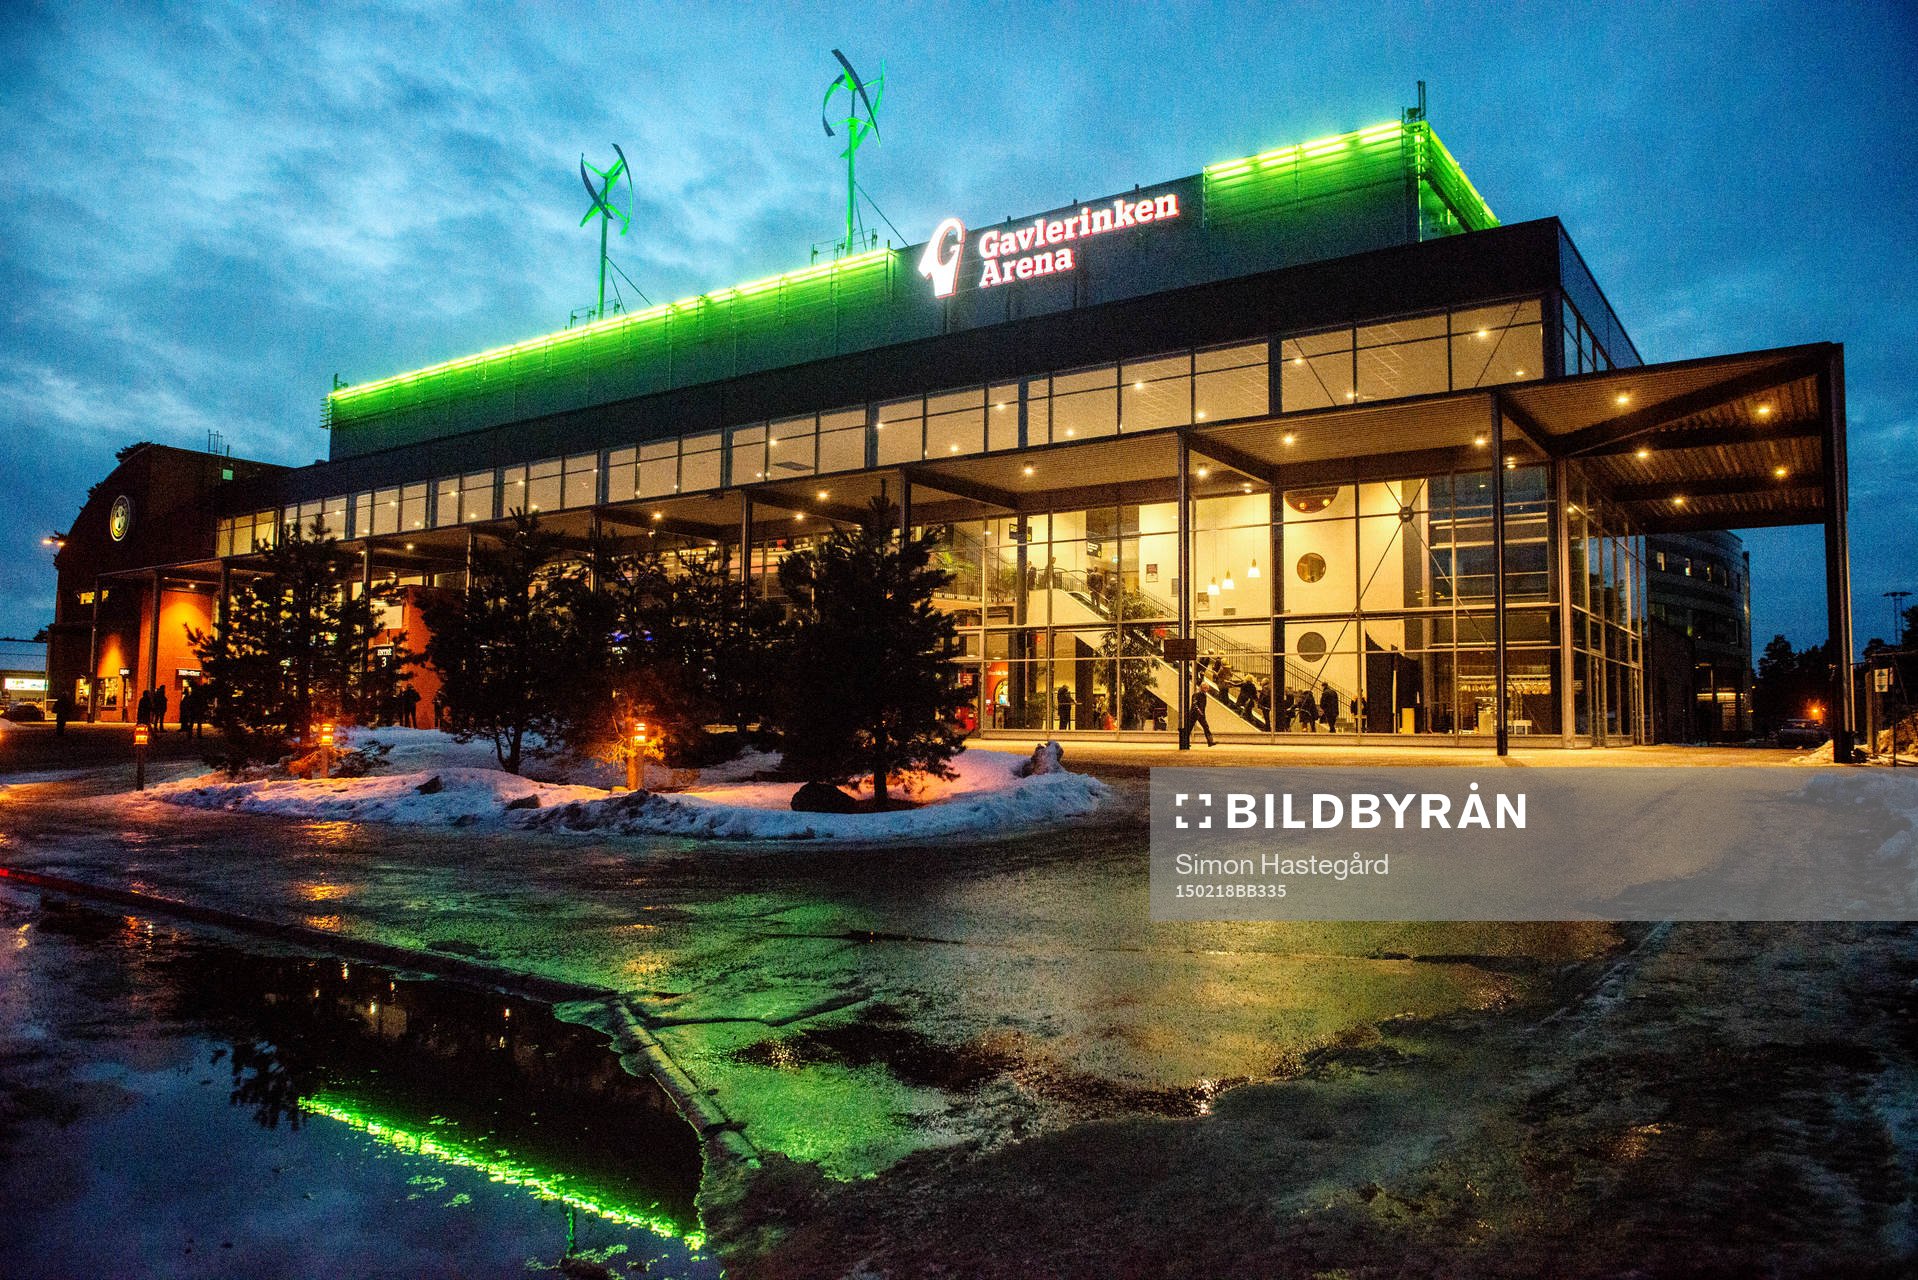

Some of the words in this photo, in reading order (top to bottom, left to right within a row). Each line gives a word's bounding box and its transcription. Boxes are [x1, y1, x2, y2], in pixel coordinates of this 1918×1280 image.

[978, 193, 1180, 260] Gavlerinken
[978, 247, 1076, 288] Arena
[381, 657, 387, 668] 3
